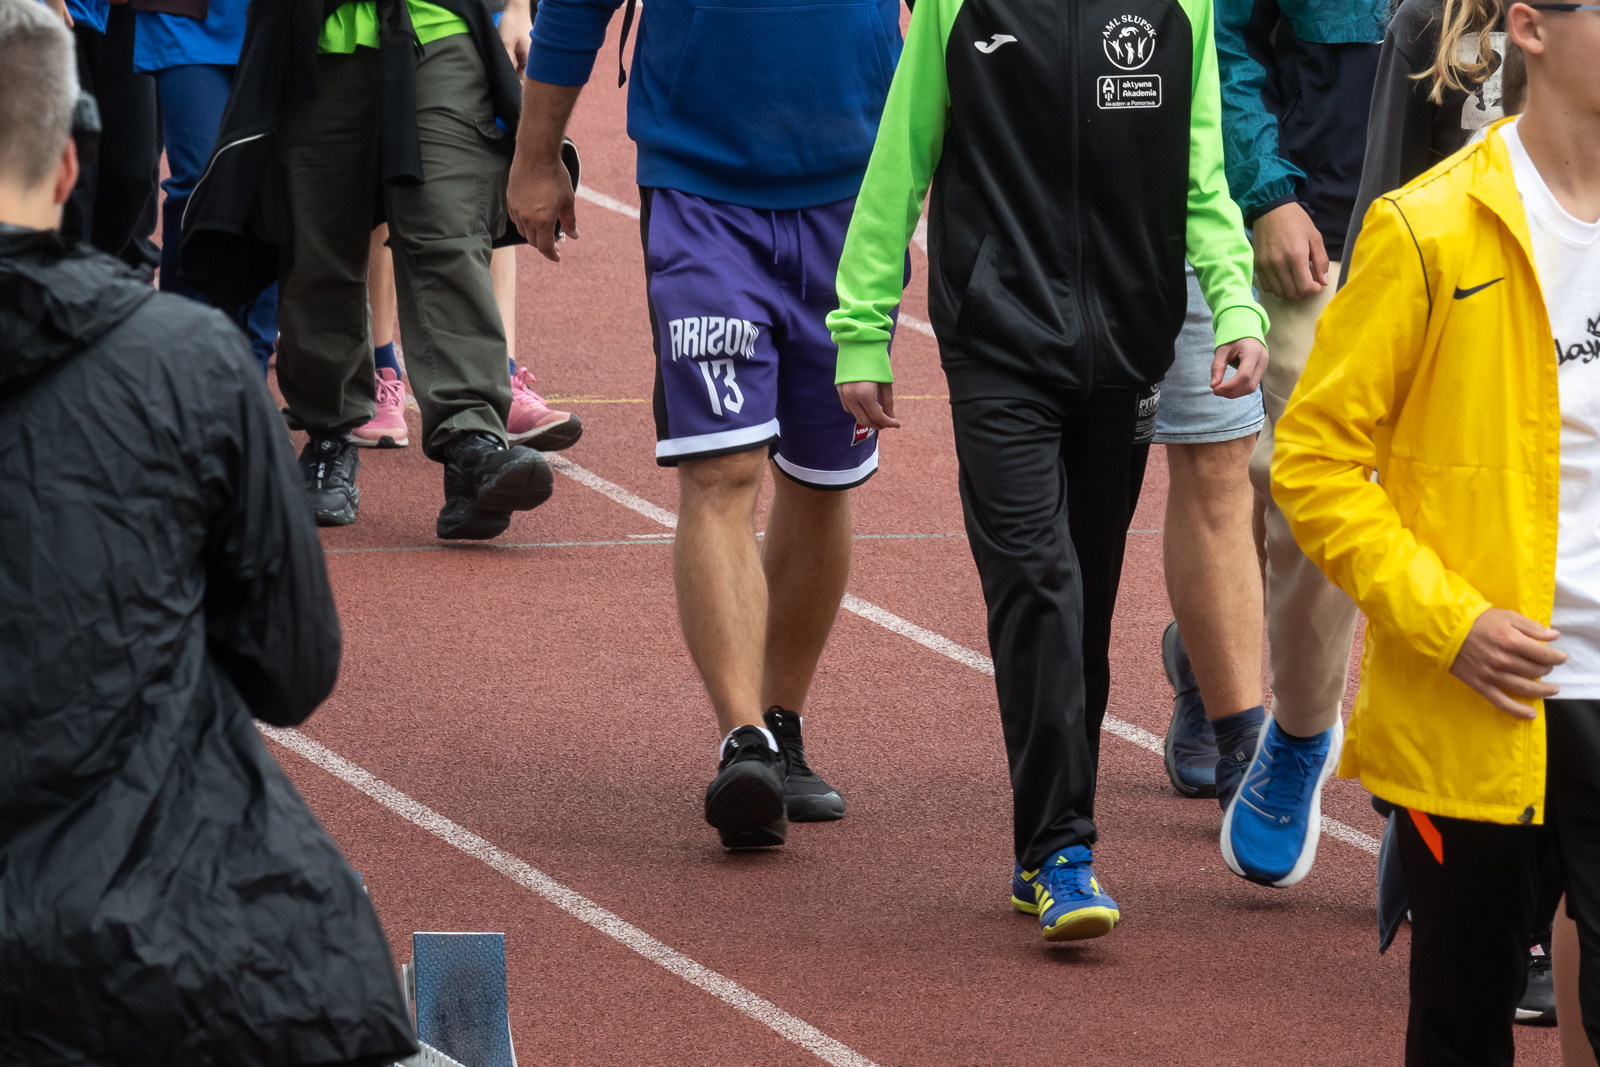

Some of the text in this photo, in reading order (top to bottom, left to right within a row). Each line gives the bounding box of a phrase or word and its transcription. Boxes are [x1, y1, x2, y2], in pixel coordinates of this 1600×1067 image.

[1102, 14, 1157, 39] AML SŁUPSK
[1122, 80, 1152, 90] aktywna
[1122, 89, 1157, 97] Akademia
[698, 358, 745, 416] 13
